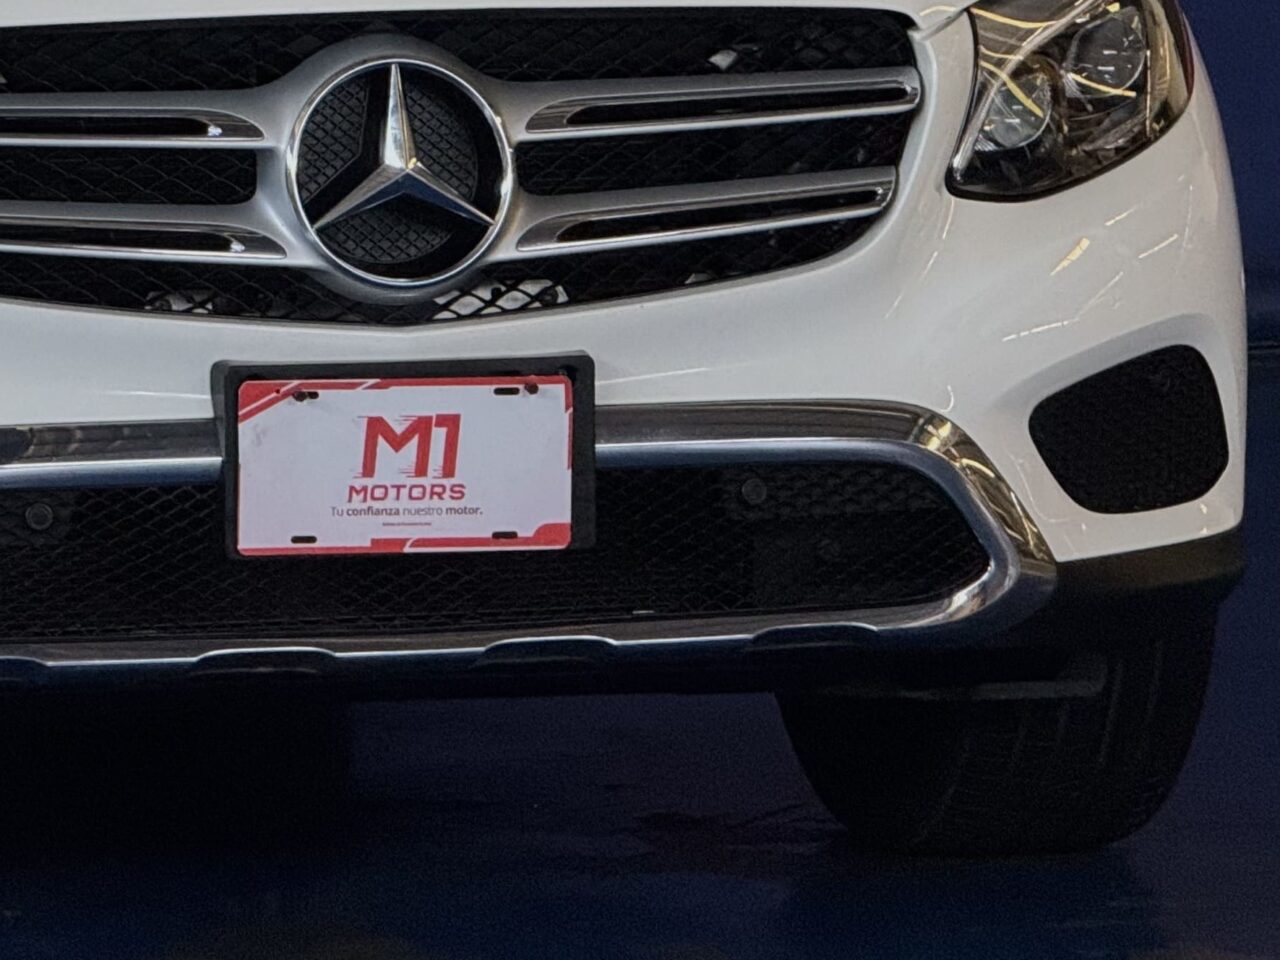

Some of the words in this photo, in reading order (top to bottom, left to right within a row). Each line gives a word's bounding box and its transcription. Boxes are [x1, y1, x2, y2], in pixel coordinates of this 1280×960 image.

[354, 413, 461, 479] M1
[347, 483, 467, 503] MOTORS
[331, 506, 344, 517] Tu
[346, 505, 400, 517] confianza
[402, 506, 444, 516] nuestro
[445, 505, 484, 516] motor.
